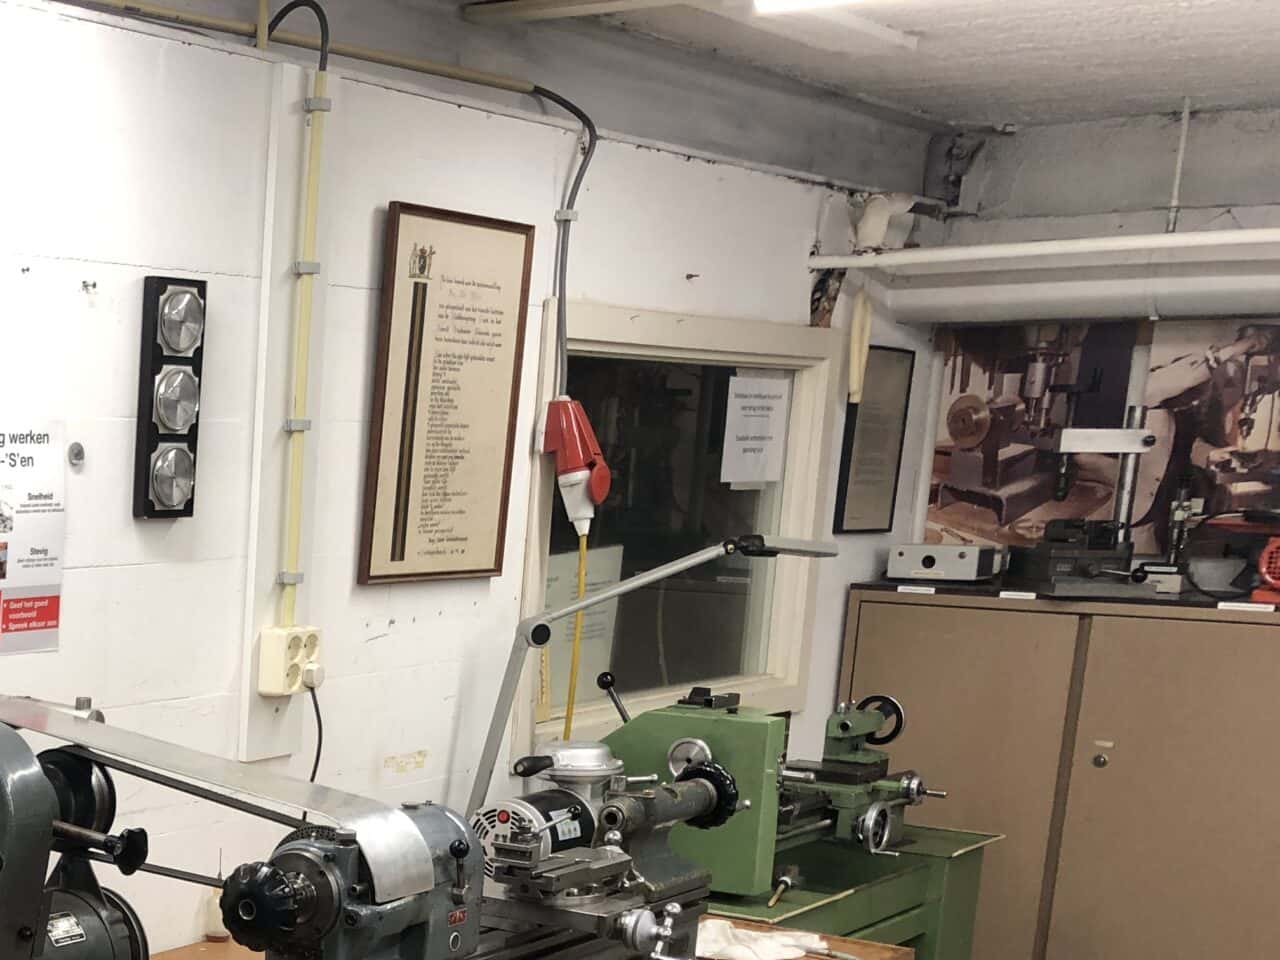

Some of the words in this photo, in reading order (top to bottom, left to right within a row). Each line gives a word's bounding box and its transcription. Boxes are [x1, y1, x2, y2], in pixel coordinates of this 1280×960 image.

[9, 430, 49, 444] werken
[28, 492, 53, 500] Snelheid
[30, 547, 48, 556] Stevig
